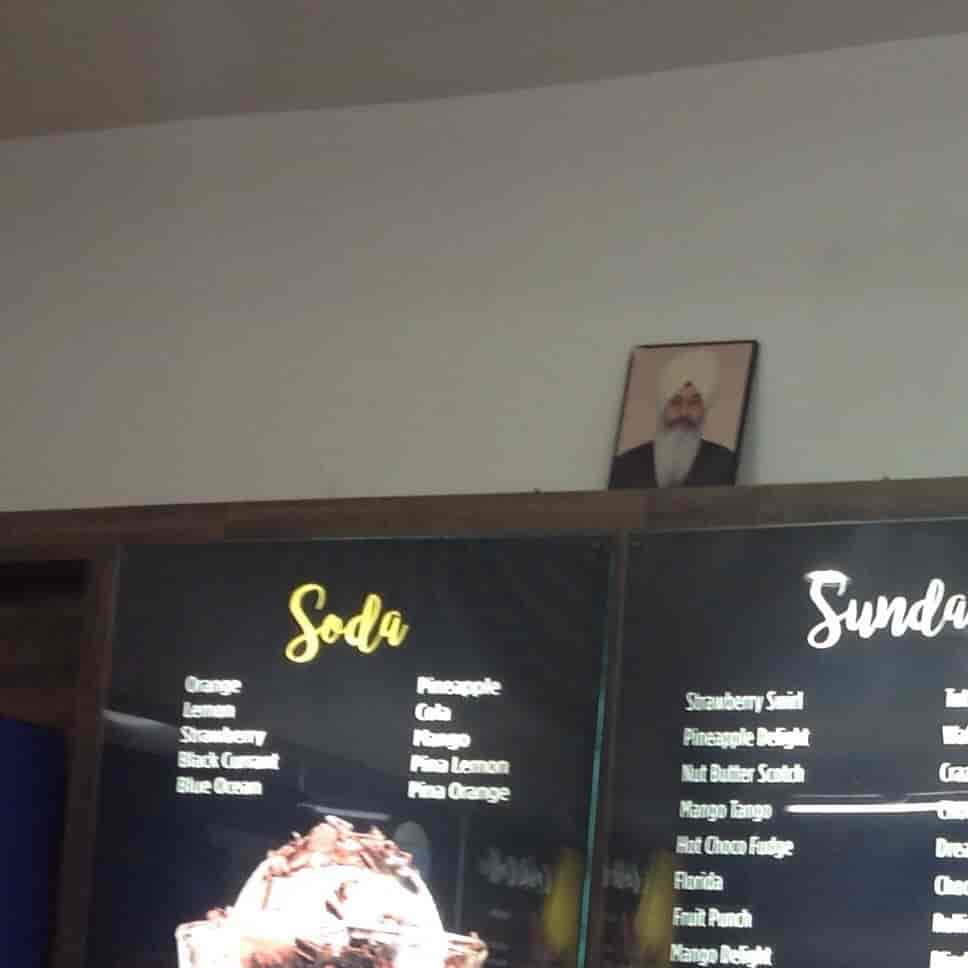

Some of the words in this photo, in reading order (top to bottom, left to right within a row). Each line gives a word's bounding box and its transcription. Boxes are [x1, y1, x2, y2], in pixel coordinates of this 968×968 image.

[285, 583, 409, 663] Soda
[184, 675, 243, 696] Orange
[416, 676, 503, 698] Pineapple
[182, 701, 237, 719] Lemon
[685, 690, 765, 714] Strawberry
[179, 725, 268, 747] Strawberry
[412, 729, 472, 751] Mango
[683, 727, 755, 750] Pineapple
[756, 727, 811, 750] Delight
[177, 751, 220, 769] Black
[409, 754, 449, 774] Pina
[450, 756, 511, 775] Lemon
[681, 763, 709, 783] Nut
[709, 763, 756, 783] Butter
[757, 763, 806, 783] Scotch
[175, 776, 213, 795] Blue
[213, 776, 264, 796] Ocean
[407, 780, 446, 800] Pina
[447, 781, 512, 804] Orange
[679, 799, 728, 822] Mango
[729, 799, 773, 822] Tango
[675, 834, 702, 855] Hot
[703, 835, 748, 856] Choco
[748, 836, 796, 859] Fudge
[673, 870, 725, 892] Florida
[671, 906, 707, 929] Fruit
[707, 907, 753, 929] Punch
[670, 943, 719, 967] Mango
[719, 944, 773, 968] Delight
